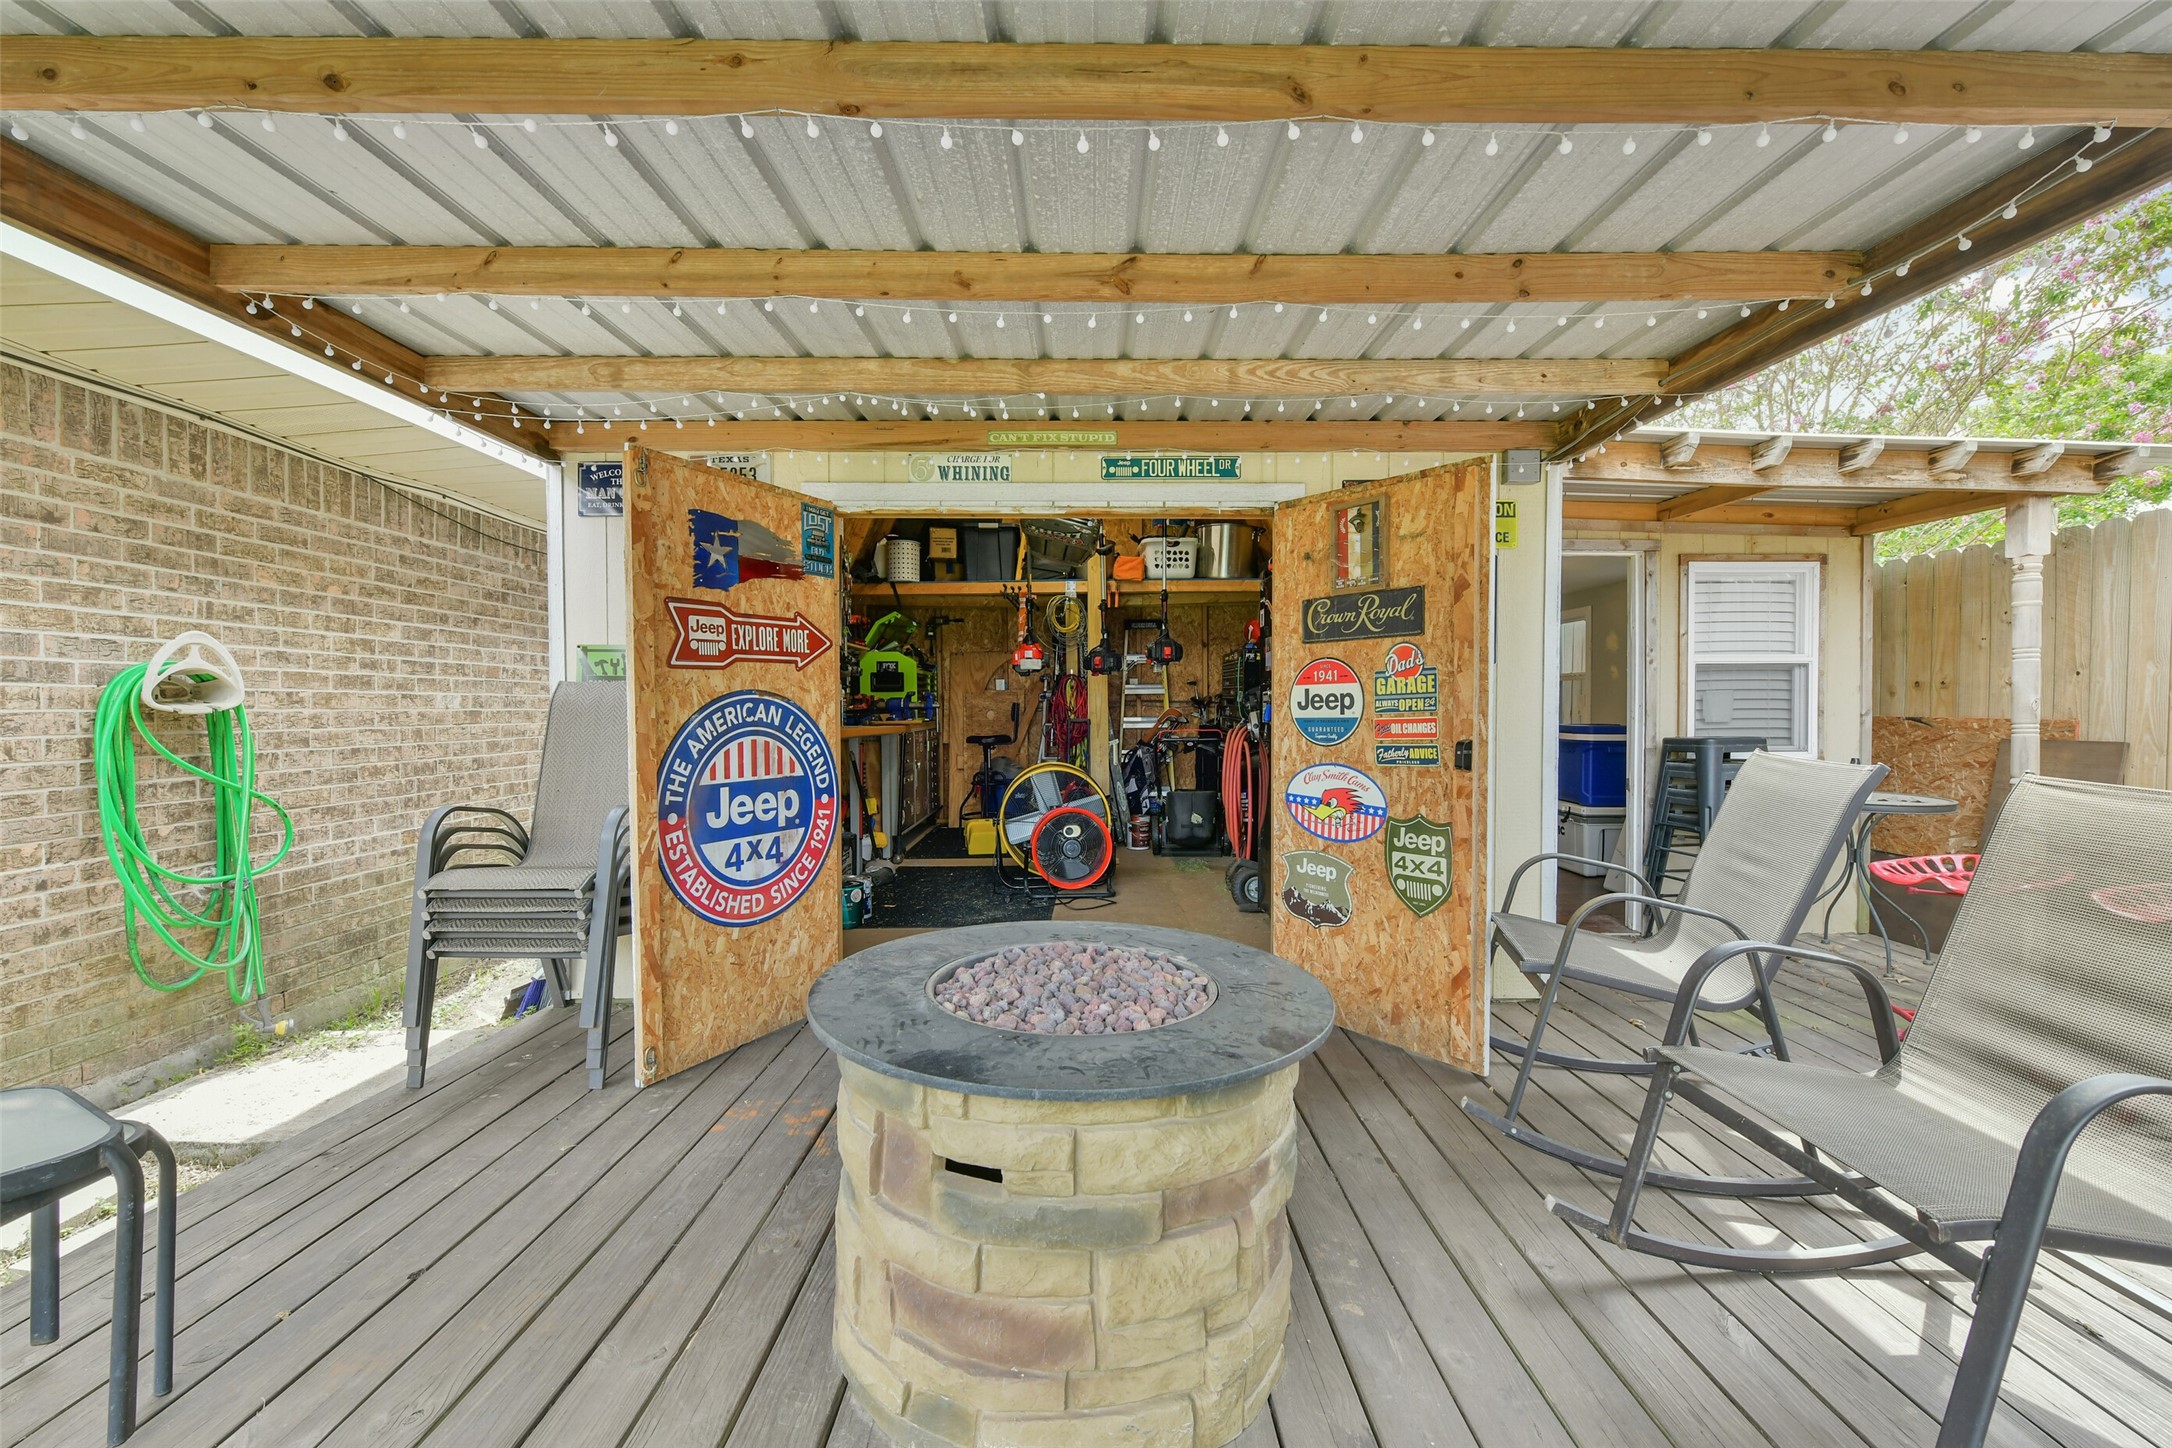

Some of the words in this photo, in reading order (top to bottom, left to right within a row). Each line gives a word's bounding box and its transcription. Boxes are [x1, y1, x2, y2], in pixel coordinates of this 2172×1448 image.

[990, 433, 1029, 442] CAN'T
[1033, 433, 1058, 442] FIX
[1060, 433, 1115, 442] STUPID
[937, 466, 1010, 481] WHINING
[1141, 460, 1175, 477] FOUR
[1178, 460, 1220, 477] WHEEL
[1219, 460, 1231, 469] DR
[585, 487, 616, 499] MAN
[803, 511, 831, 533] LOST
[1307, 599, 1356, 634] Crown
[1341, 593, 1417, 633] Royal
[690, 619, 724, 637] Jeep
[731, 624, 779, 651] EXPLORE
[783, 628, 810, 653] MORE
[1386, 649, 1424, 676] Dad's
[1314, 670, 1338, 682] 1941
[1376, 675, 1435, 695] GARAGE
[1297, 689, 1355, 715] Jeep
[1399, 698, 1424, 711] OPEN
[1391, 723, 1402, 734] OIL
[1402, 722, 1436, 734] CHANGES
[665, 758, 692, 805] THE
[686, 702, 782, 759] AMERICAN
[785, 715, 830, 788] LEGEND
[1377, 747, 1409, 761] Fatherly
[1409, 748, 1437, 759] ADVICE
[1304, 772, 1321, 784] Clay
[1322, 769, 1348, 782] Smith
[1347, 775, 1370, 792] Cams
[706, 787, 800, 828] Jeep
[1393, 827, 1446, 856] Jeep
[665, 829, 764, 915] ESTABLISHED
[770, 853, 815, 905] SINCE
[811, 809, 830, 849] 1941
[1296, 858, 1337, 882] Jeep
